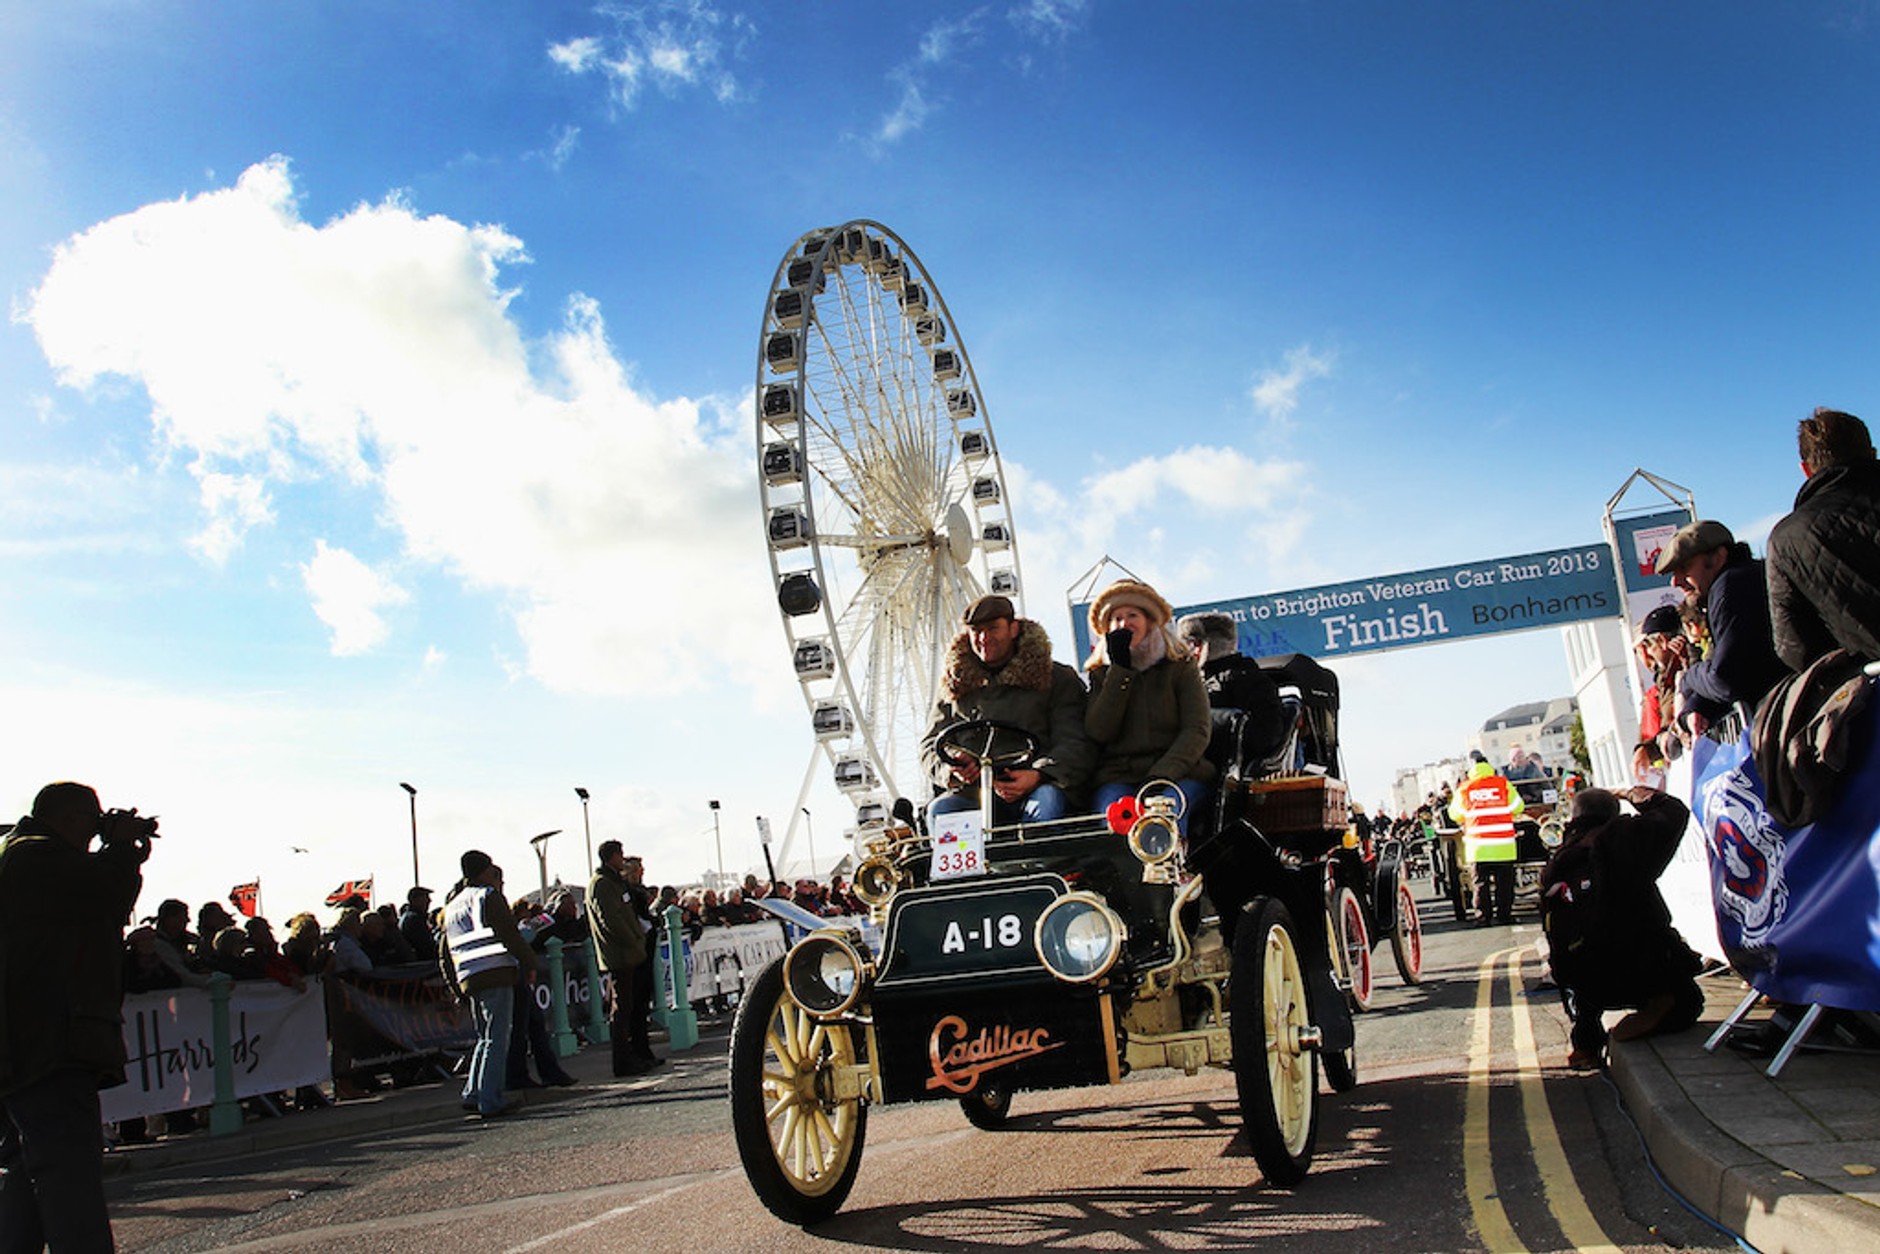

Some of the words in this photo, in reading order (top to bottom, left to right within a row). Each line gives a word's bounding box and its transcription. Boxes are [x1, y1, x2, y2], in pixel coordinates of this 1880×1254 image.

[1250, 605, 1270, 621] to
[1274, 590, 1365, 617] Brighton
[1366, 577, 1450, 602] Veteran
[1454, 569, 1495, 589] Car
[1499, 563, 1543, 583] Run
[1547, 551, 1600, 577] 2013
[1471, 591, 1607, 625] Bonhams
[1321, 602, 1449, 651] Finish
[1468, 787, 1501, 803] RAC
[938, 850, 978, 873] 338
[942, 913, 1022, 955] A-18
[123, 1009, 261, 1092] Harrds
[926, 1015, 1064, 1094] Cadillac
